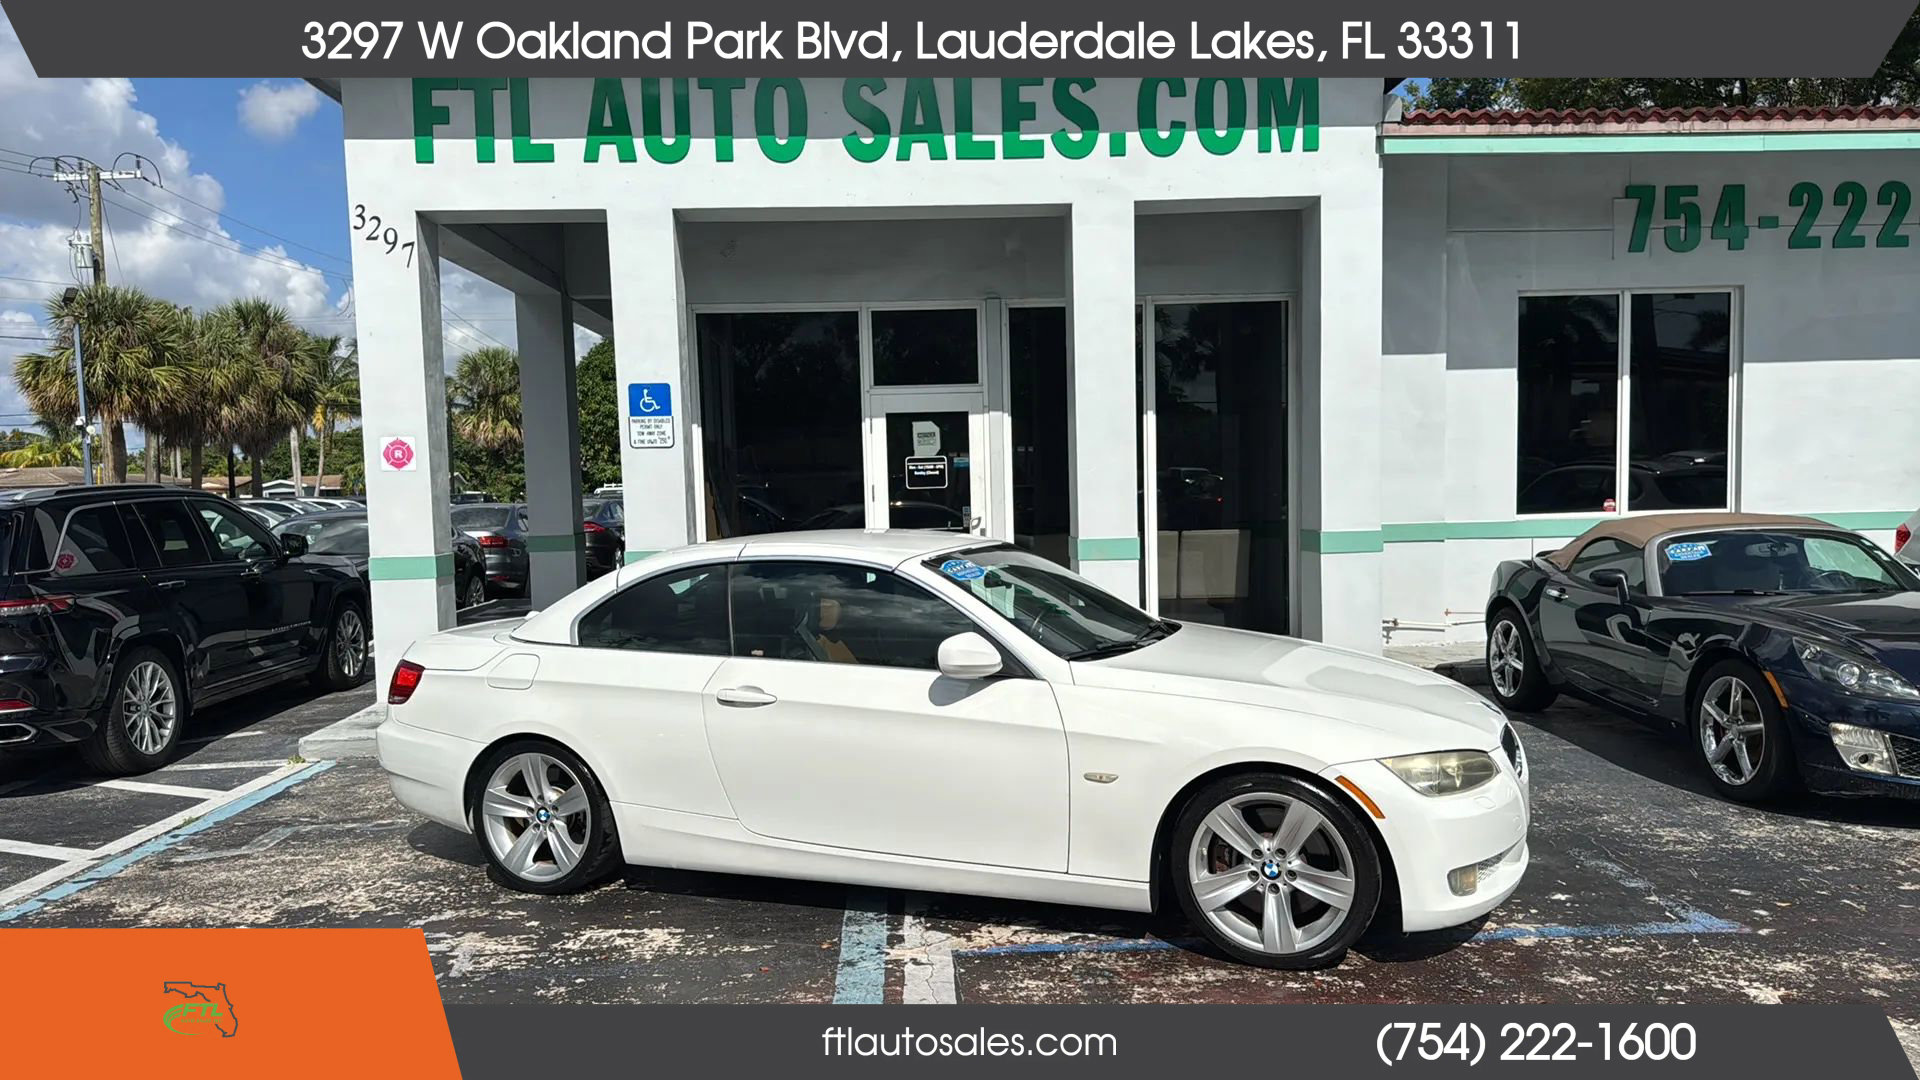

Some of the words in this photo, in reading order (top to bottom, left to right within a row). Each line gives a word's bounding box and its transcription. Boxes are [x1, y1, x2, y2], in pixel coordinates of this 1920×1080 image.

[411, 78, 555, 164] FTL
[583, 78, 808, 164] AUTO
[842, 78, 1320, 163] SALES.COM
[353, 204, 415, 268] 3297
[1625, 180, 1912, 253] 754-222
